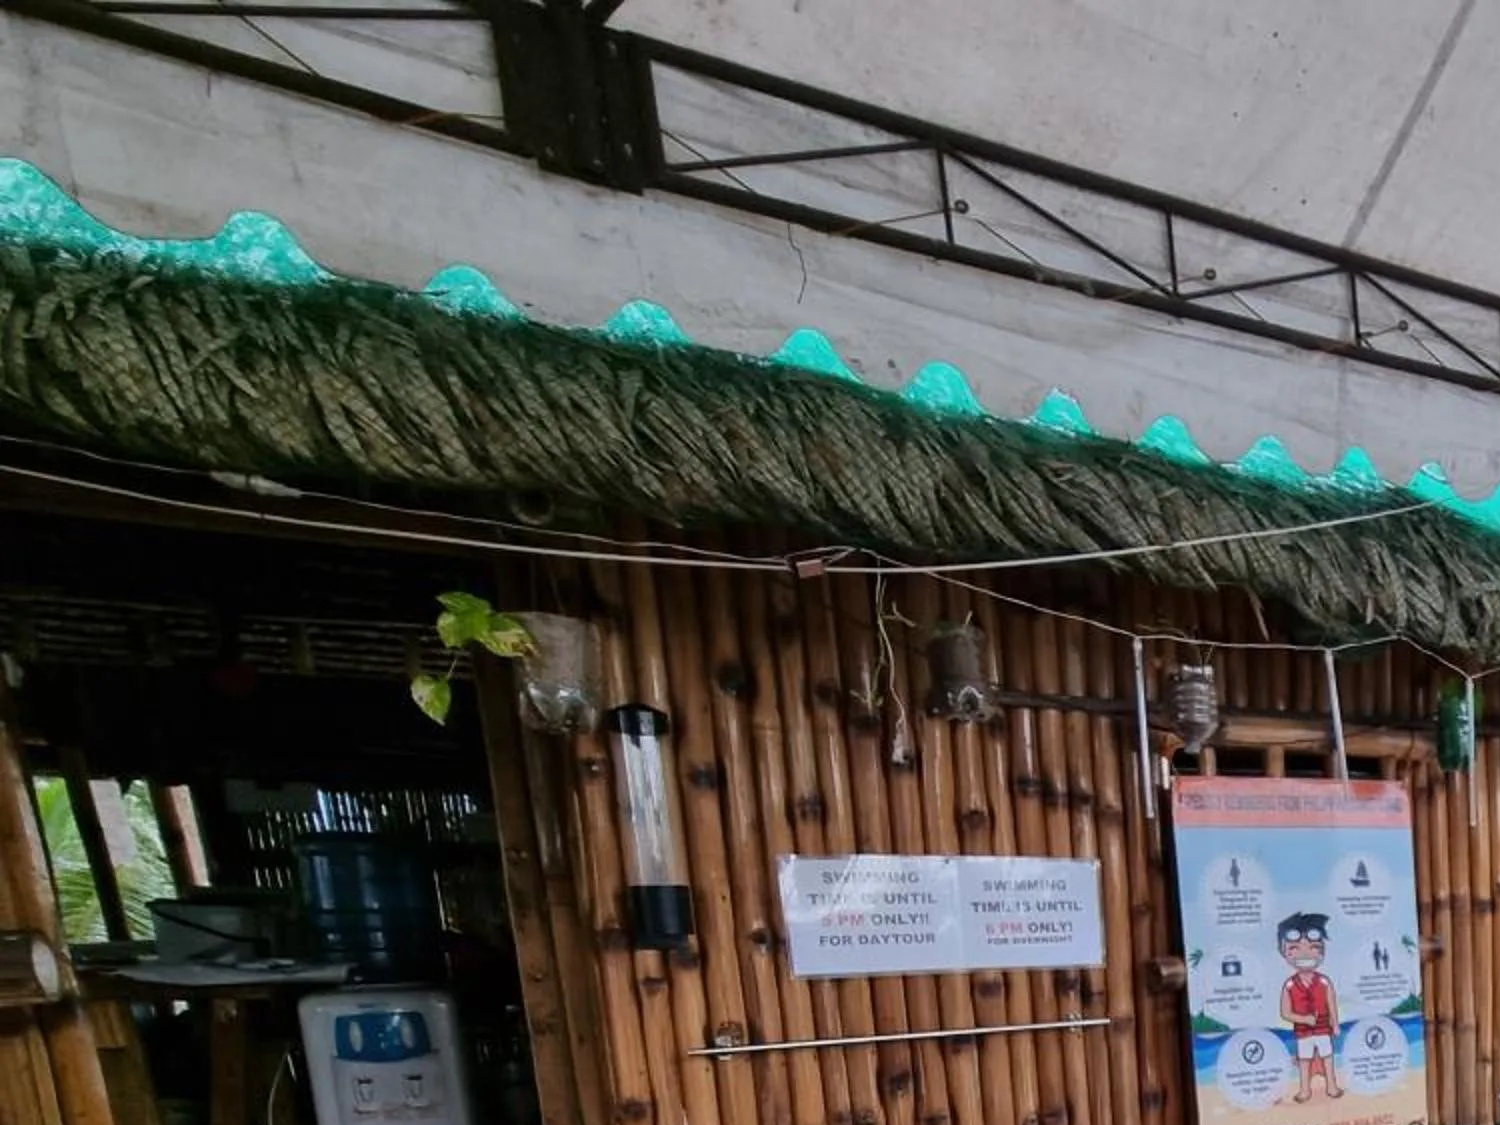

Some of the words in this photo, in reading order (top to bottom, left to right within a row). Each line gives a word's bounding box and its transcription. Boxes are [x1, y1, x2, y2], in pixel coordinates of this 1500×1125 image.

[822, 871, 920, 885] SWING
[808, 892, 856, 905] TIM
[884, 892, 938, 905] UNTIL
[1035, 899, 1085, 912] UNTIL
[838, 911, 864, 927] PM
[1000, 920, 1023, 934] PM
[818, 935, 852, 947] FOR
[858, 932, 936, 945] DAYTOUR
[987, 936, 1009, 945] FOR
